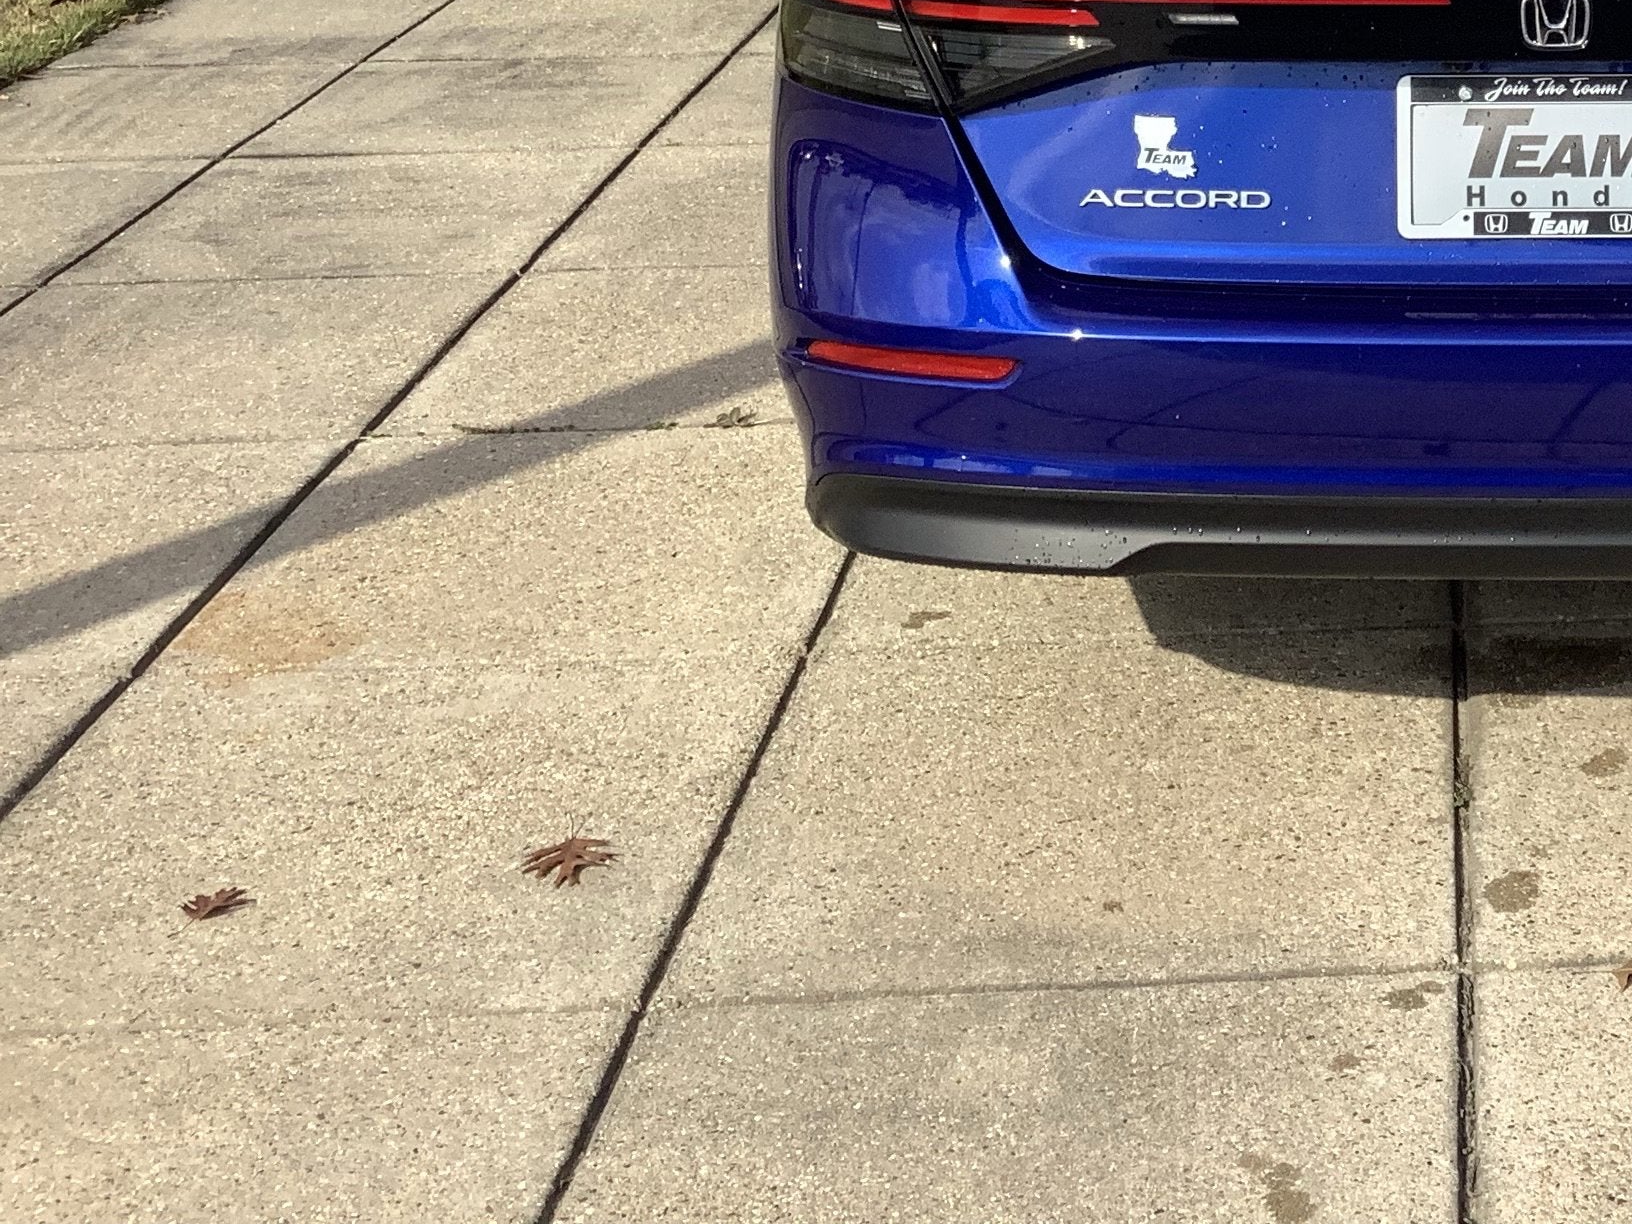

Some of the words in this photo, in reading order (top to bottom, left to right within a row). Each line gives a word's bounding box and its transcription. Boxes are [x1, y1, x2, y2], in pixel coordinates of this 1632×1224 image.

[1484, 78, 1530, 102] Join
[1534, 78, 1567, 96] The
[1569, 78, 1628, 96] Team!
[1143, 147, 1187, 165] TEAM
[1079, 189, 1272, 209] ACCORD
[1529, 212, 1589, 235] TEAM
